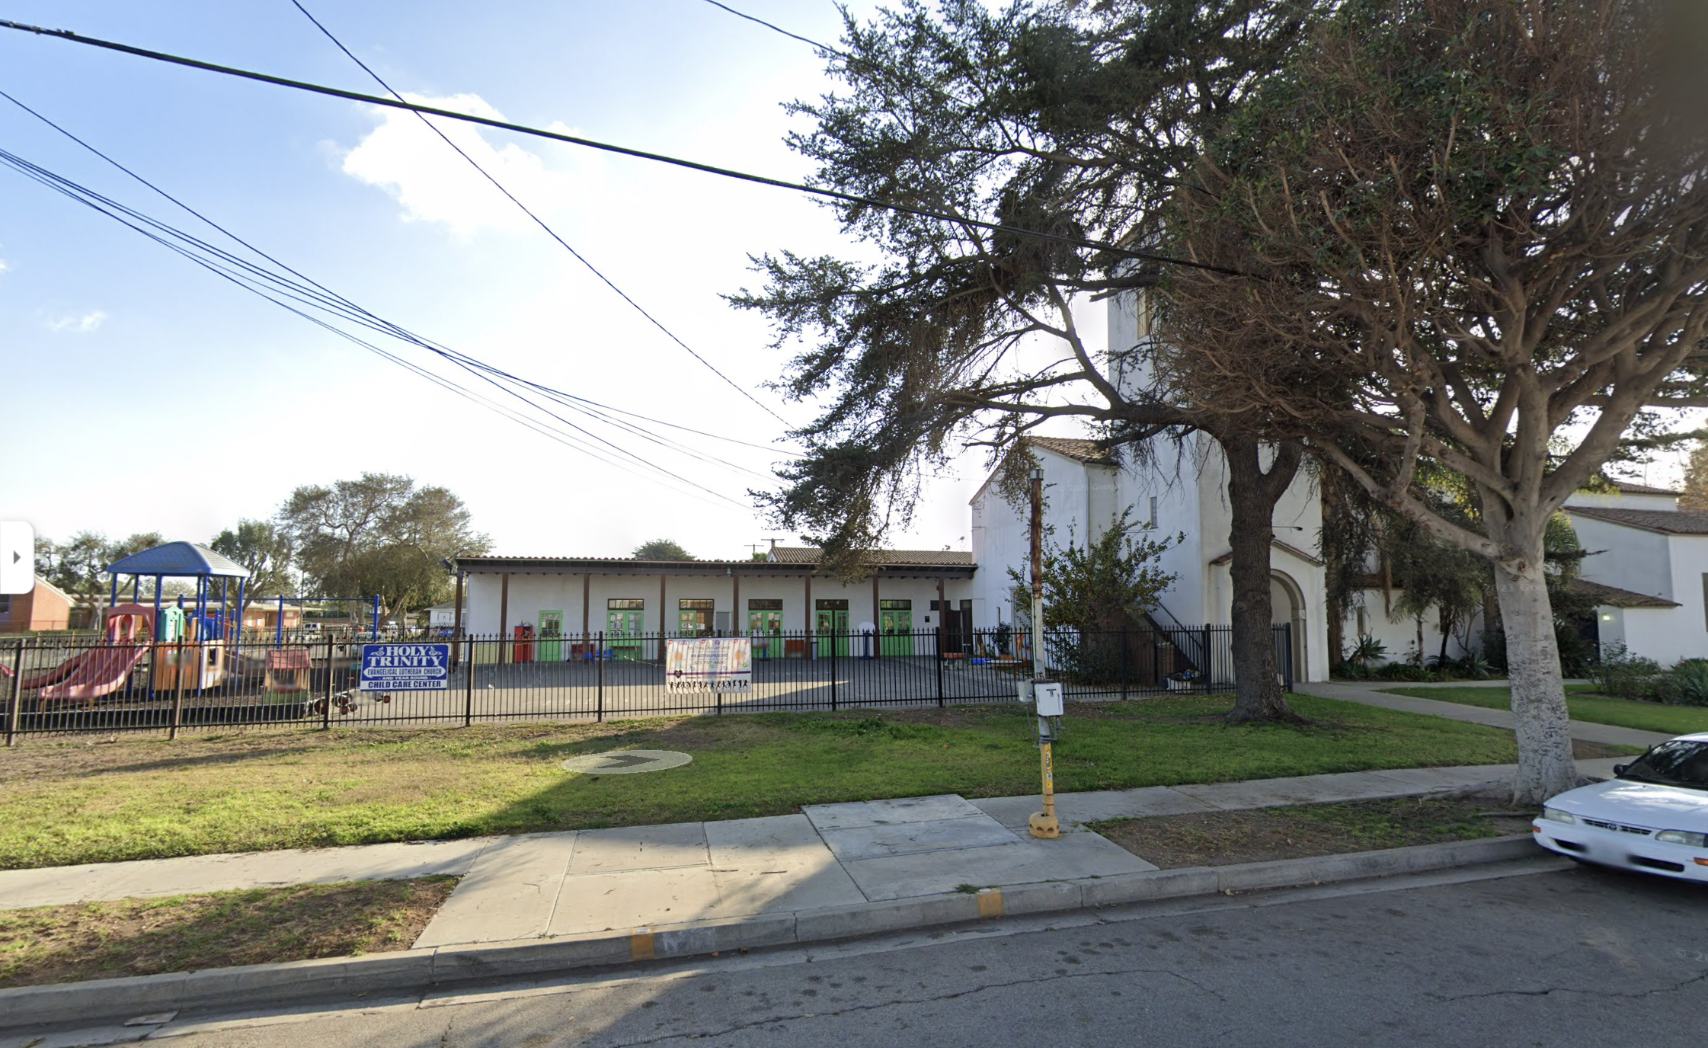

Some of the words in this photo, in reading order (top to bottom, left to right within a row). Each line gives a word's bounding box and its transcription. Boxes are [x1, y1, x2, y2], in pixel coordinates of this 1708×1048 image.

[386, 646, 429, 656] HOLY
[367, 656, 443, 667] TRINITY
[368, 681, 391, 689] CHILD
[413, 680, 441, 688] CENTER
